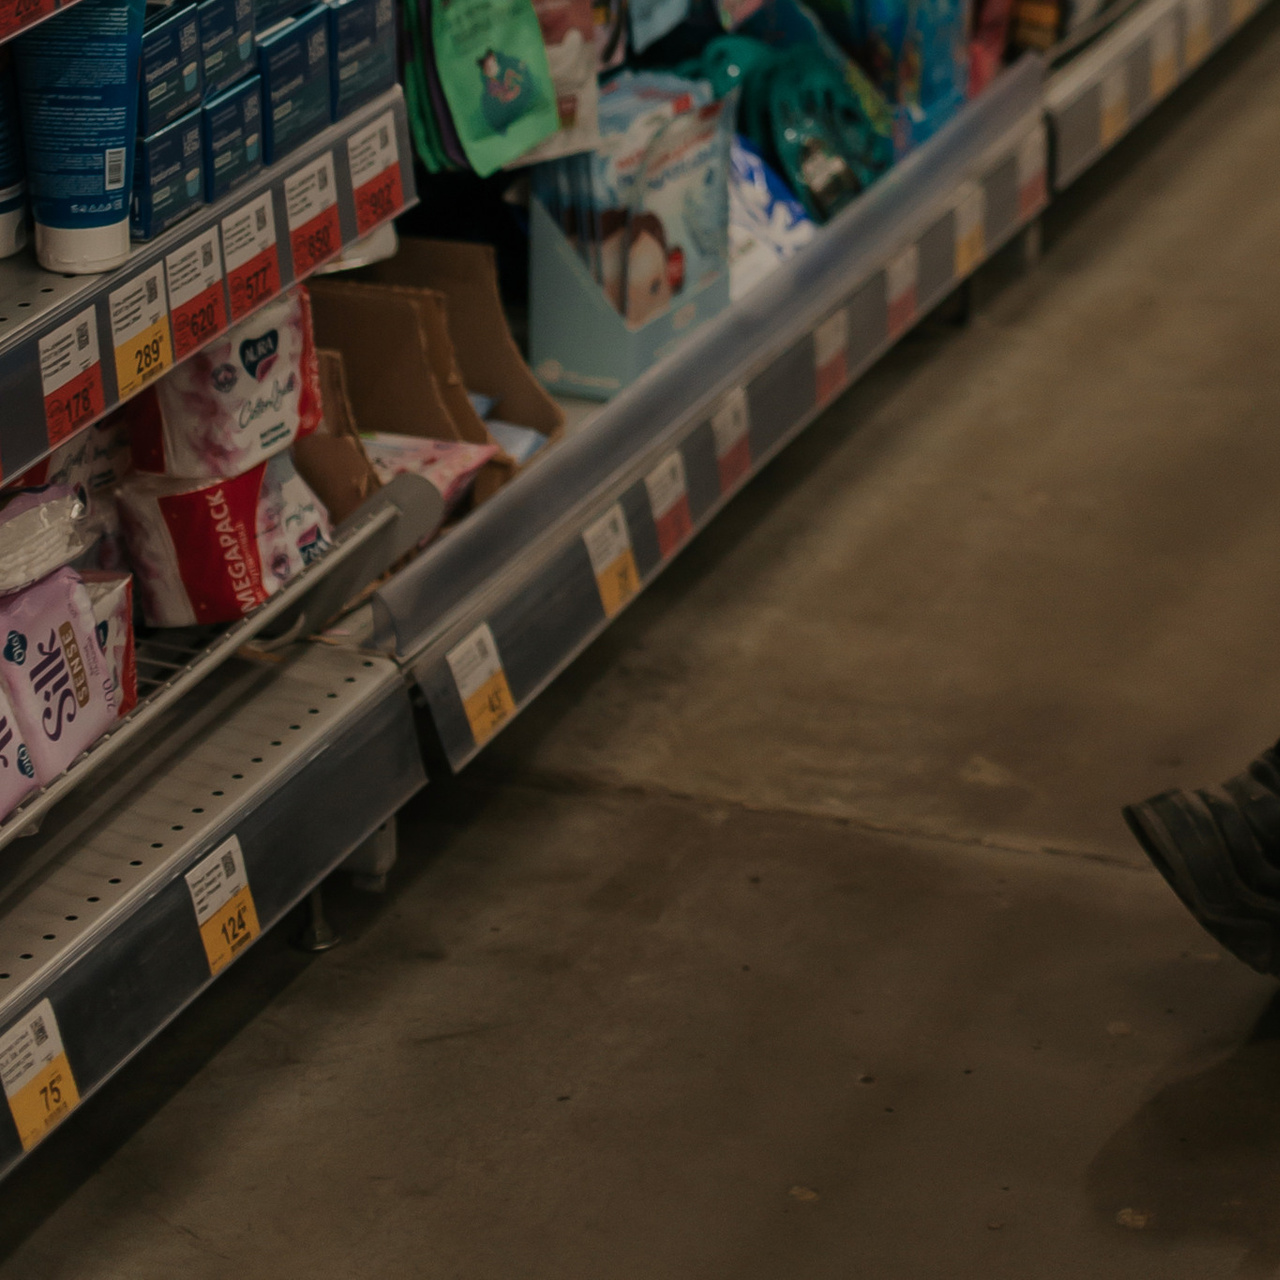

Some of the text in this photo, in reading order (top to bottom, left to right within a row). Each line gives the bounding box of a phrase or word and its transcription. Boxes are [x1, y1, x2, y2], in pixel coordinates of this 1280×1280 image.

[246, 272, 269, 306] 577
[189, 305, 216, 340] 620
[134, 346, 161, 377] 289
[63, 389, 91, 424] 178
[205, 488, 257, 613] MEGAPACK
[61, 626, 89, 703] SENSE
[29, 628, 77, 742] Silk
[220, 911, 247, 946] 124
[39, 1077, 62, 1110] 75
